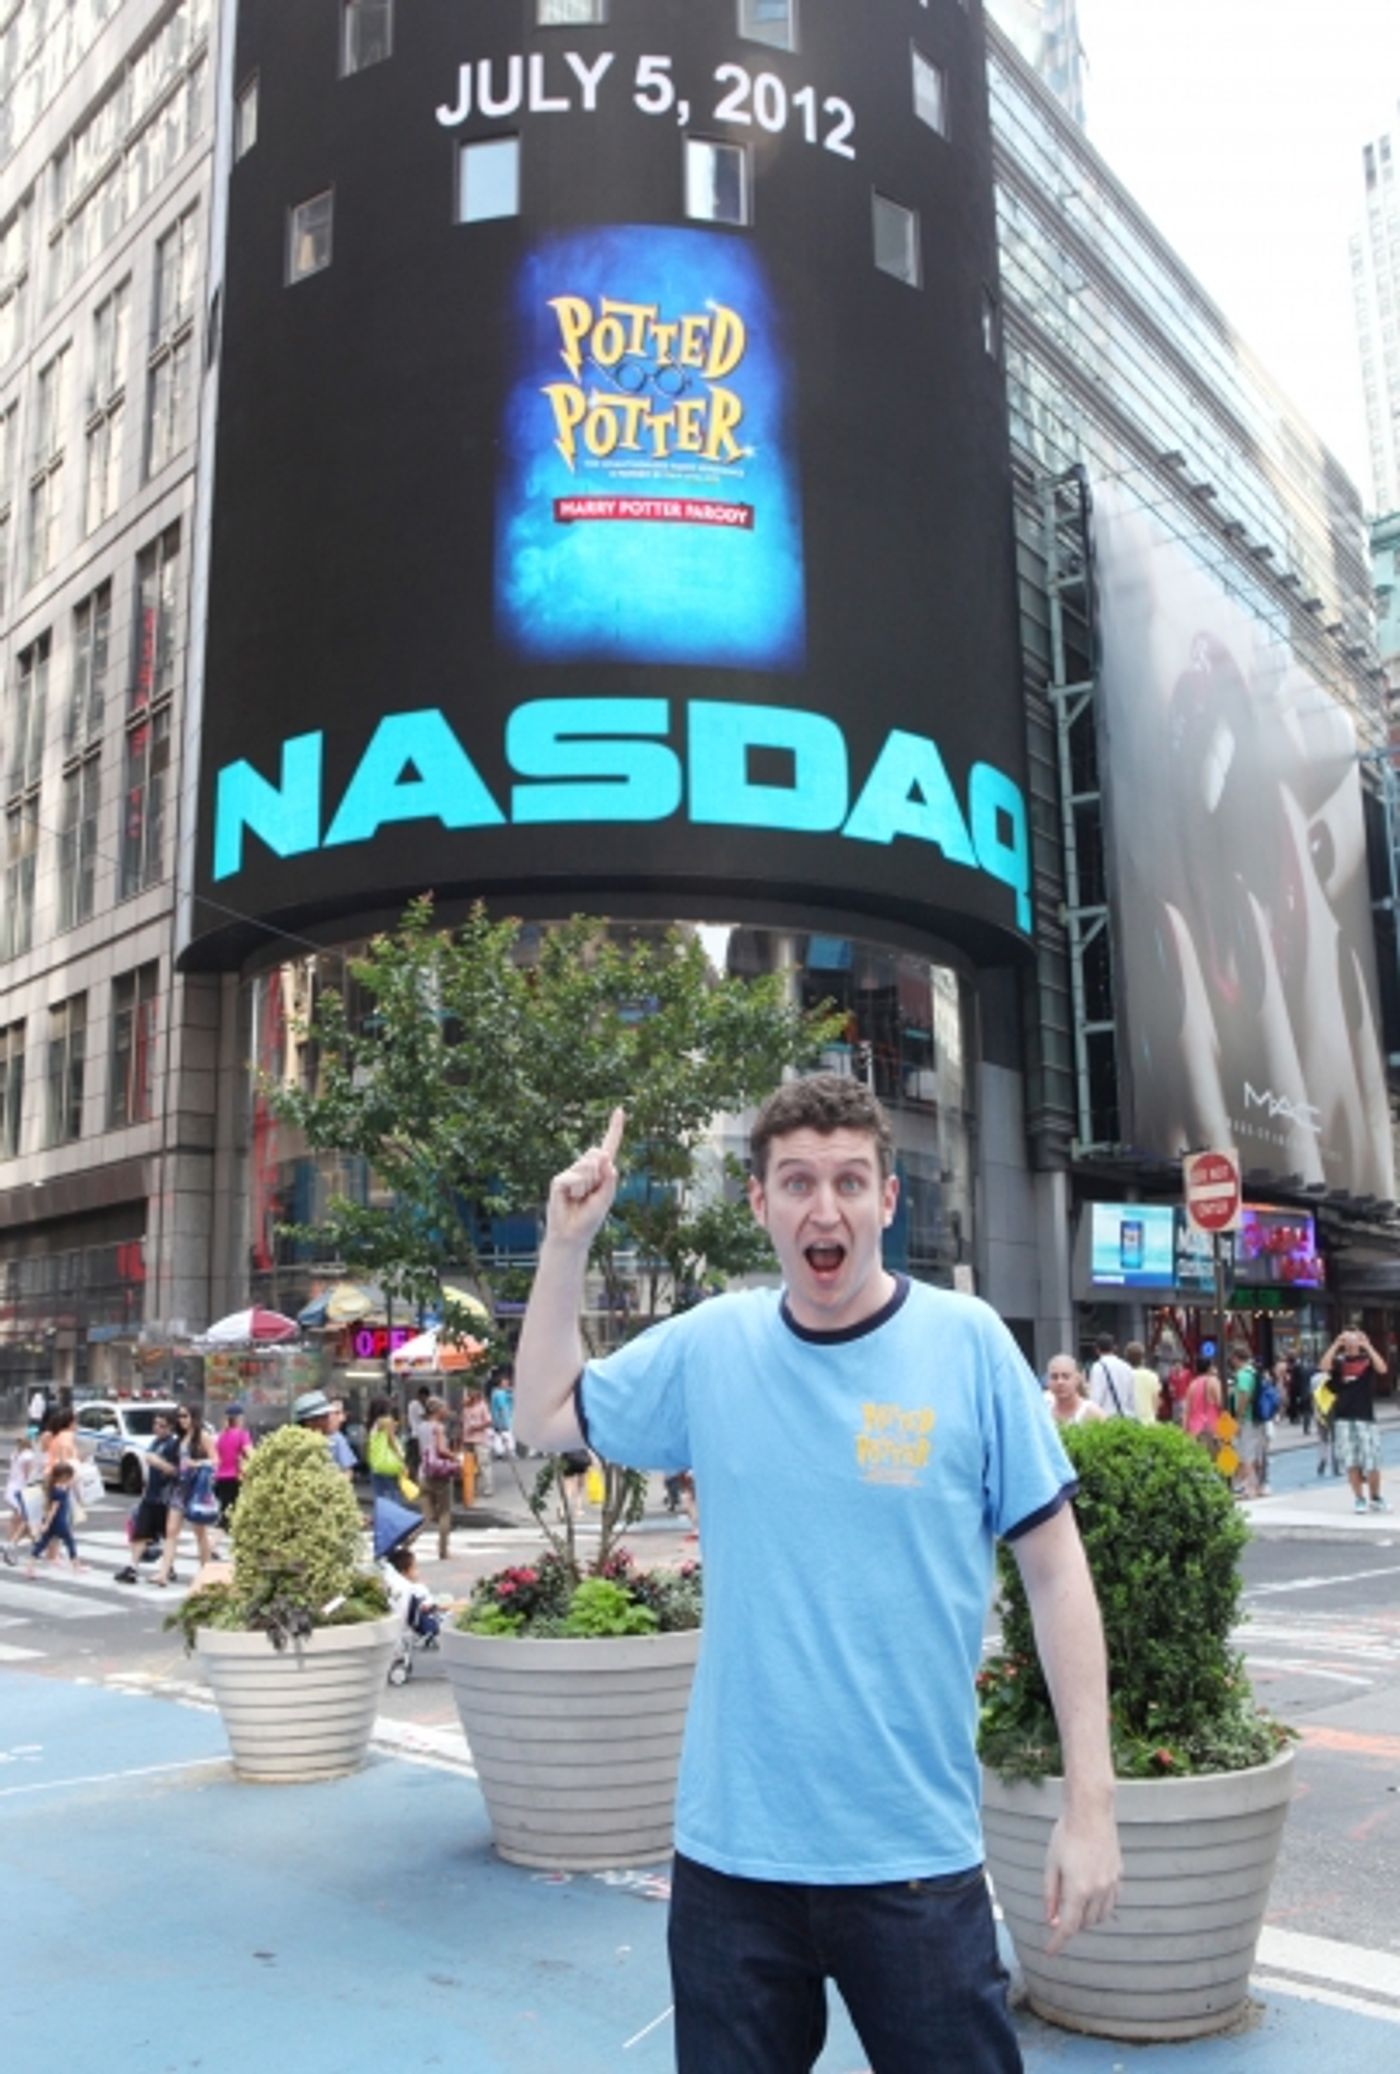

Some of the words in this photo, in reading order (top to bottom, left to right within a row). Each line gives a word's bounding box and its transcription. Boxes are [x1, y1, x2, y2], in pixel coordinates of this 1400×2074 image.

[435, 52, 615, 127] JULY
[633, 55, 690, 126] 5,
[713, 63, 856, 160] 2012
[546, 296, 746, 385] POTTED
[540, 382, 746, 475] POTTER
[559, 500, 617, 517] HARRY
[618, 501, 682, 518] POTTER
[684, 502, 749, 524] PARODY
[213, 697, 1033, 935] NASDAQ
